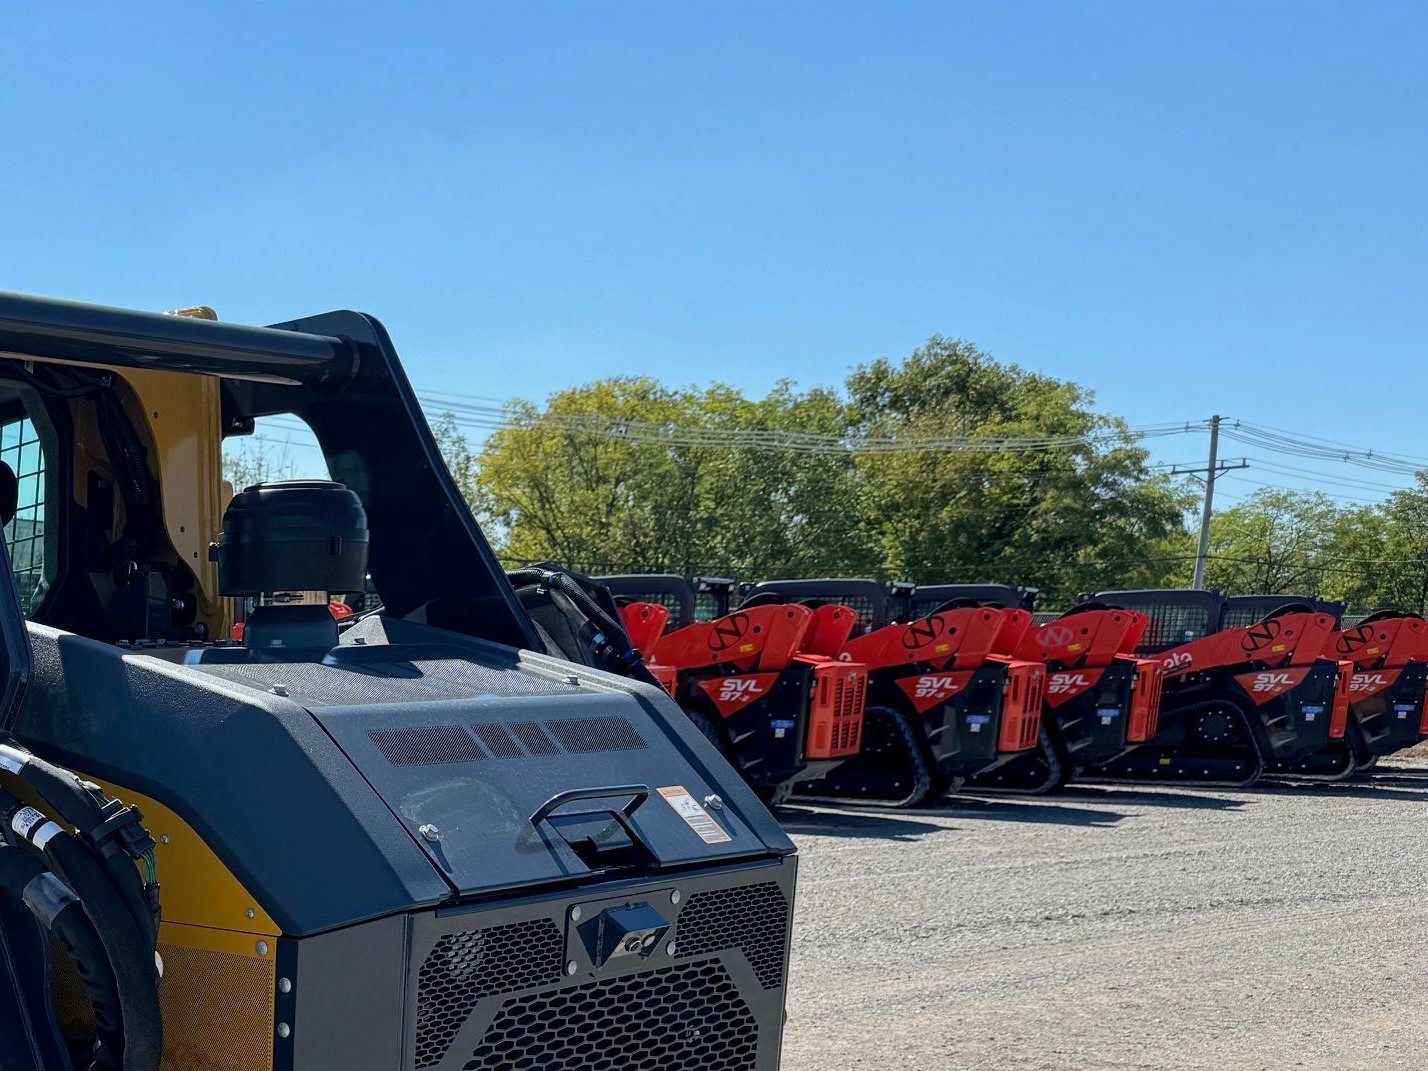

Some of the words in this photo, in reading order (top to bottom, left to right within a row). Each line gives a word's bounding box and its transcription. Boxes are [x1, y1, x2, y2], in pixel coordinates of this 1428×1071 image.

[916, 677, 959, 689] SVL
[1048, 674, 1090, 686] SVL
[1254, 673, 1294, 684] SVL
[1350, 674, 1387, 684] SVL
[720, 679, 763, 692] SVL
